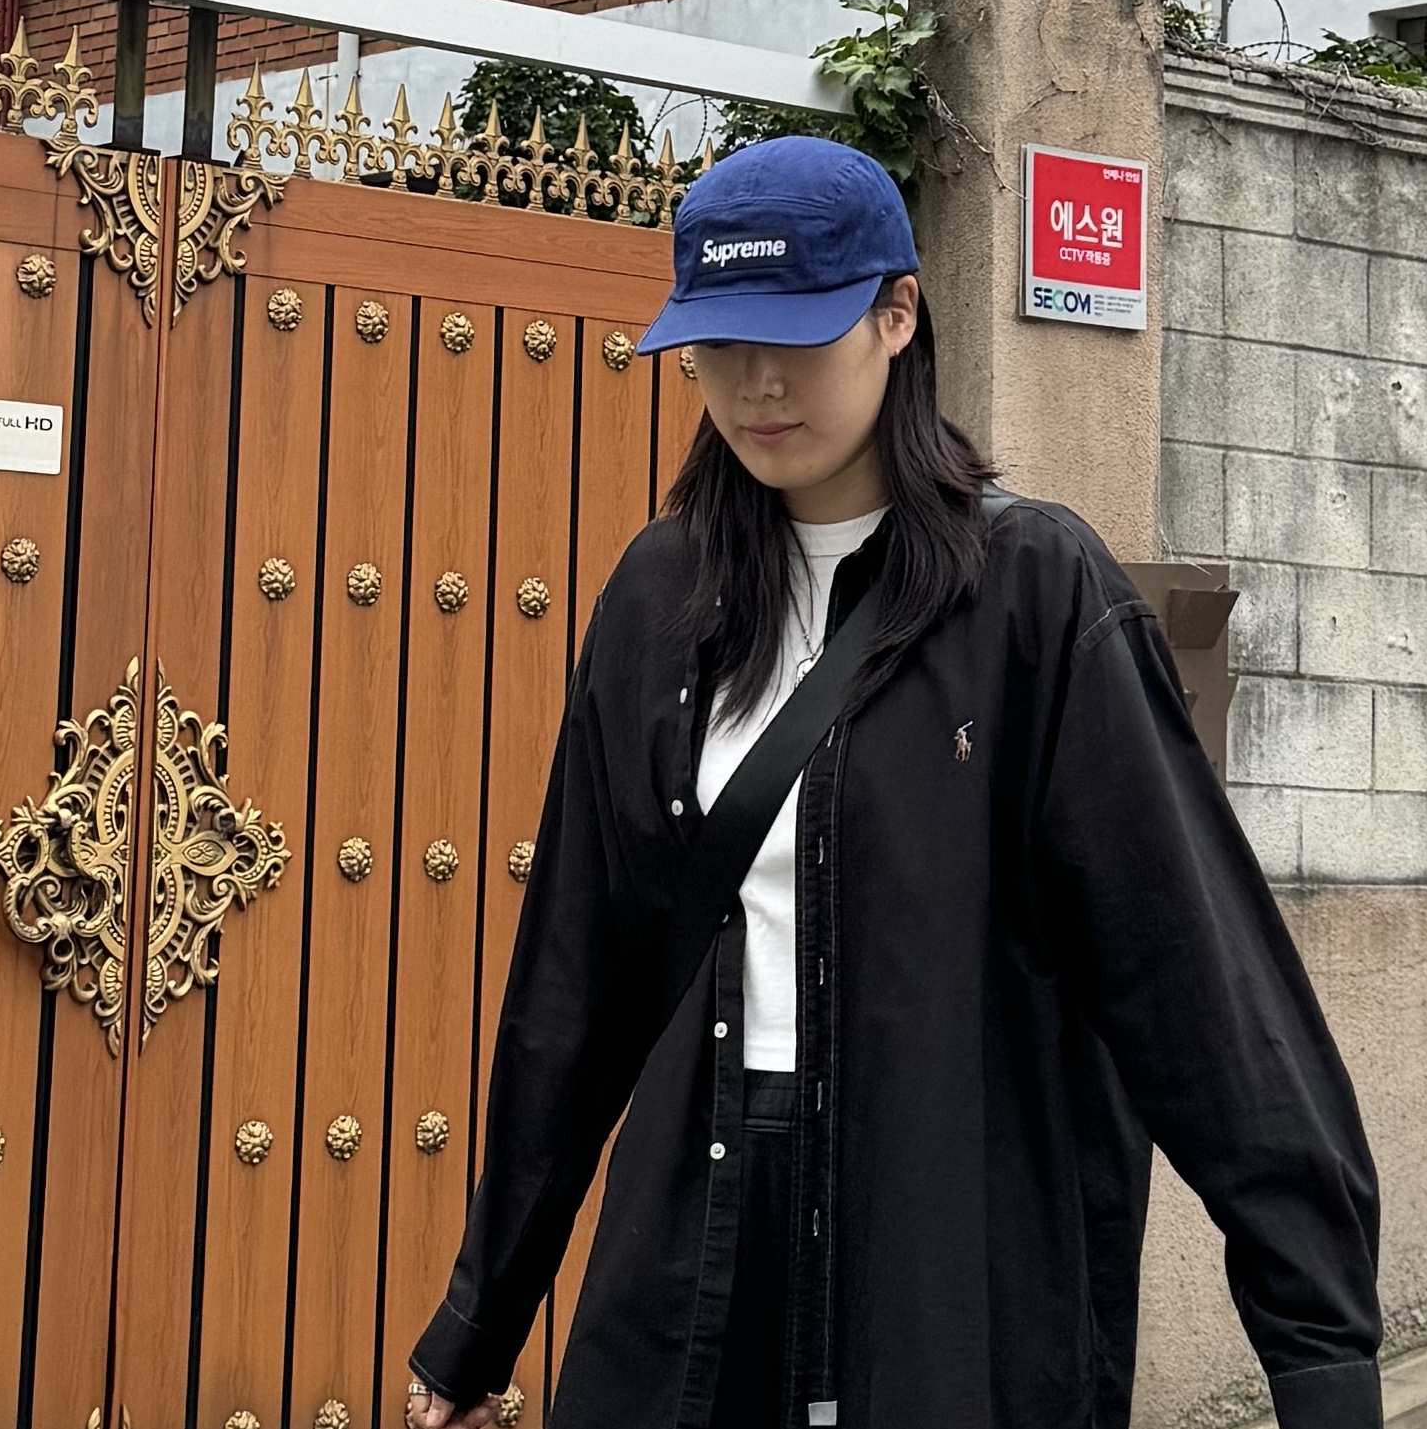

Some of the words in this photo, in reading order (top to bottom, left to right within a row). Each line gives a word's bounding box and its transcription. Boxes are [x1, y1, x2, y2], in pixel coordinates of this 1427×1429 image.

[1050, 199, 1123, 249] 에스원
[701, 239, 787, 267] Supreme
[1033, 286, 1091, 315] SECOM
[24, 415, 54, 432] HD
